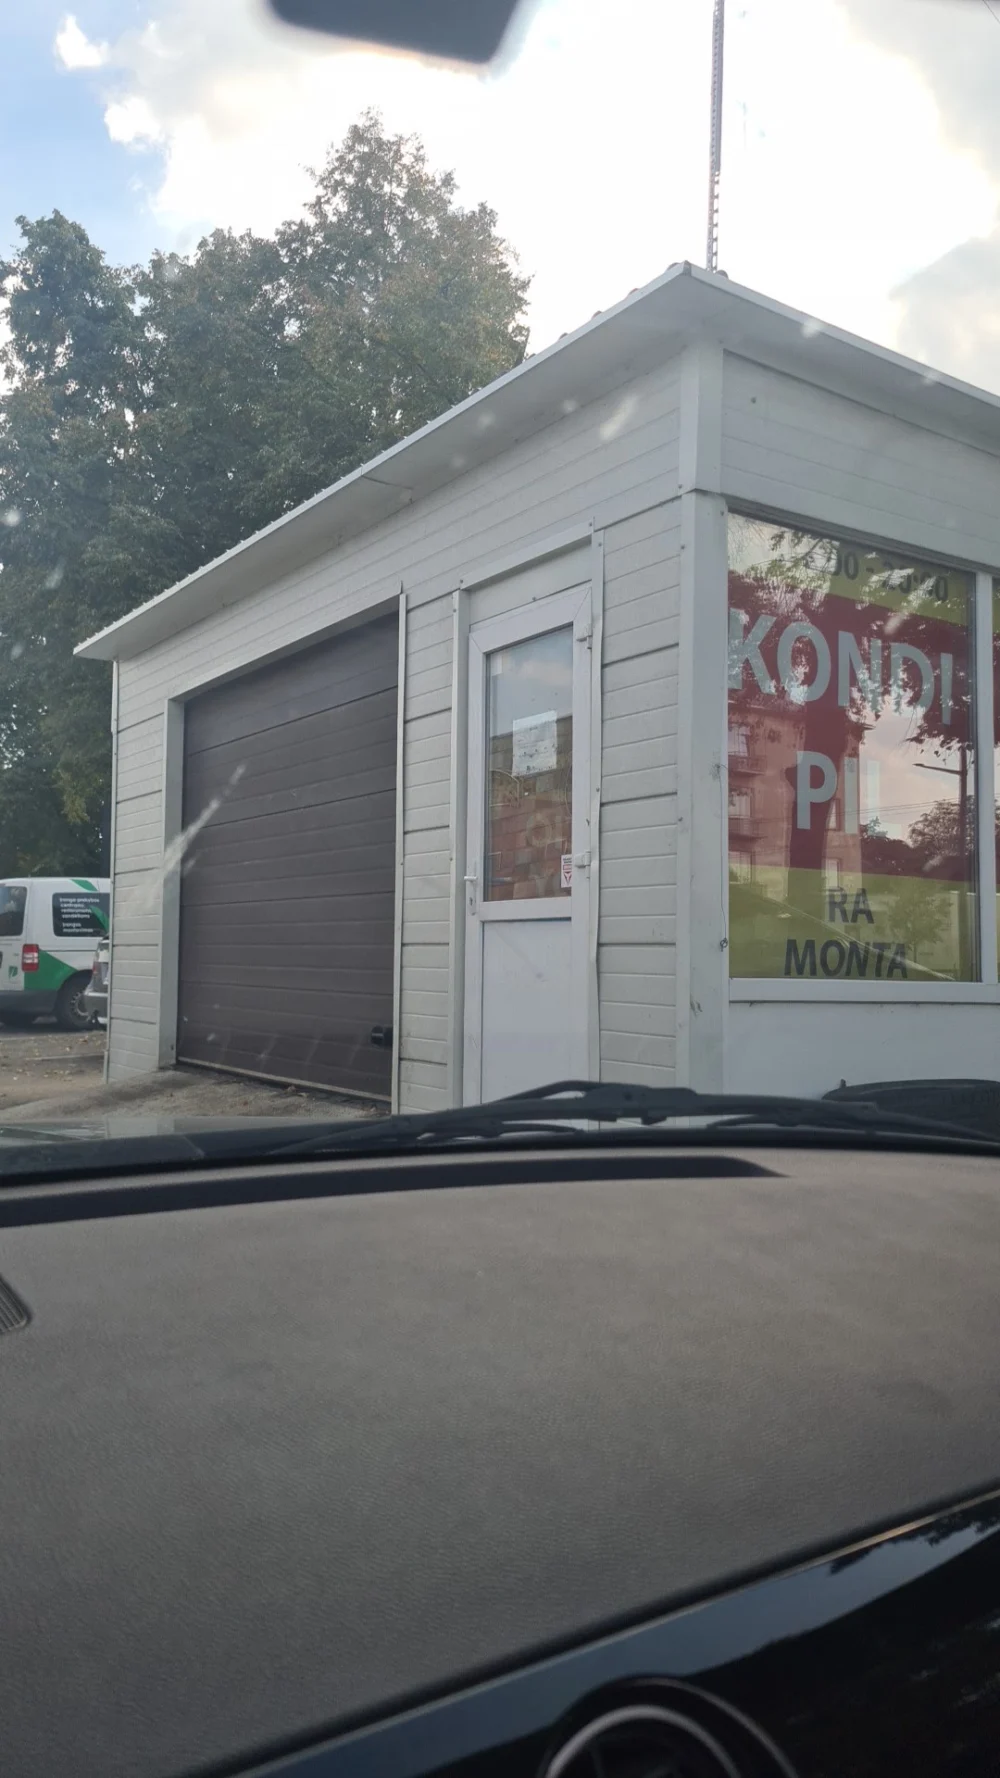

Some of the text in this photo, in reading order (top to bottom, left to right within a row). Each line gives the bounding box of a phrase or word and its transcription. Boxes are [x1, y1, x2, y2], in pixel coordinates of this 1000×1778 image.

[728, 608, 953, 725] KONDI
[828, 886, 875, 924] RA
[784, 938, 909, 979] MONTA
